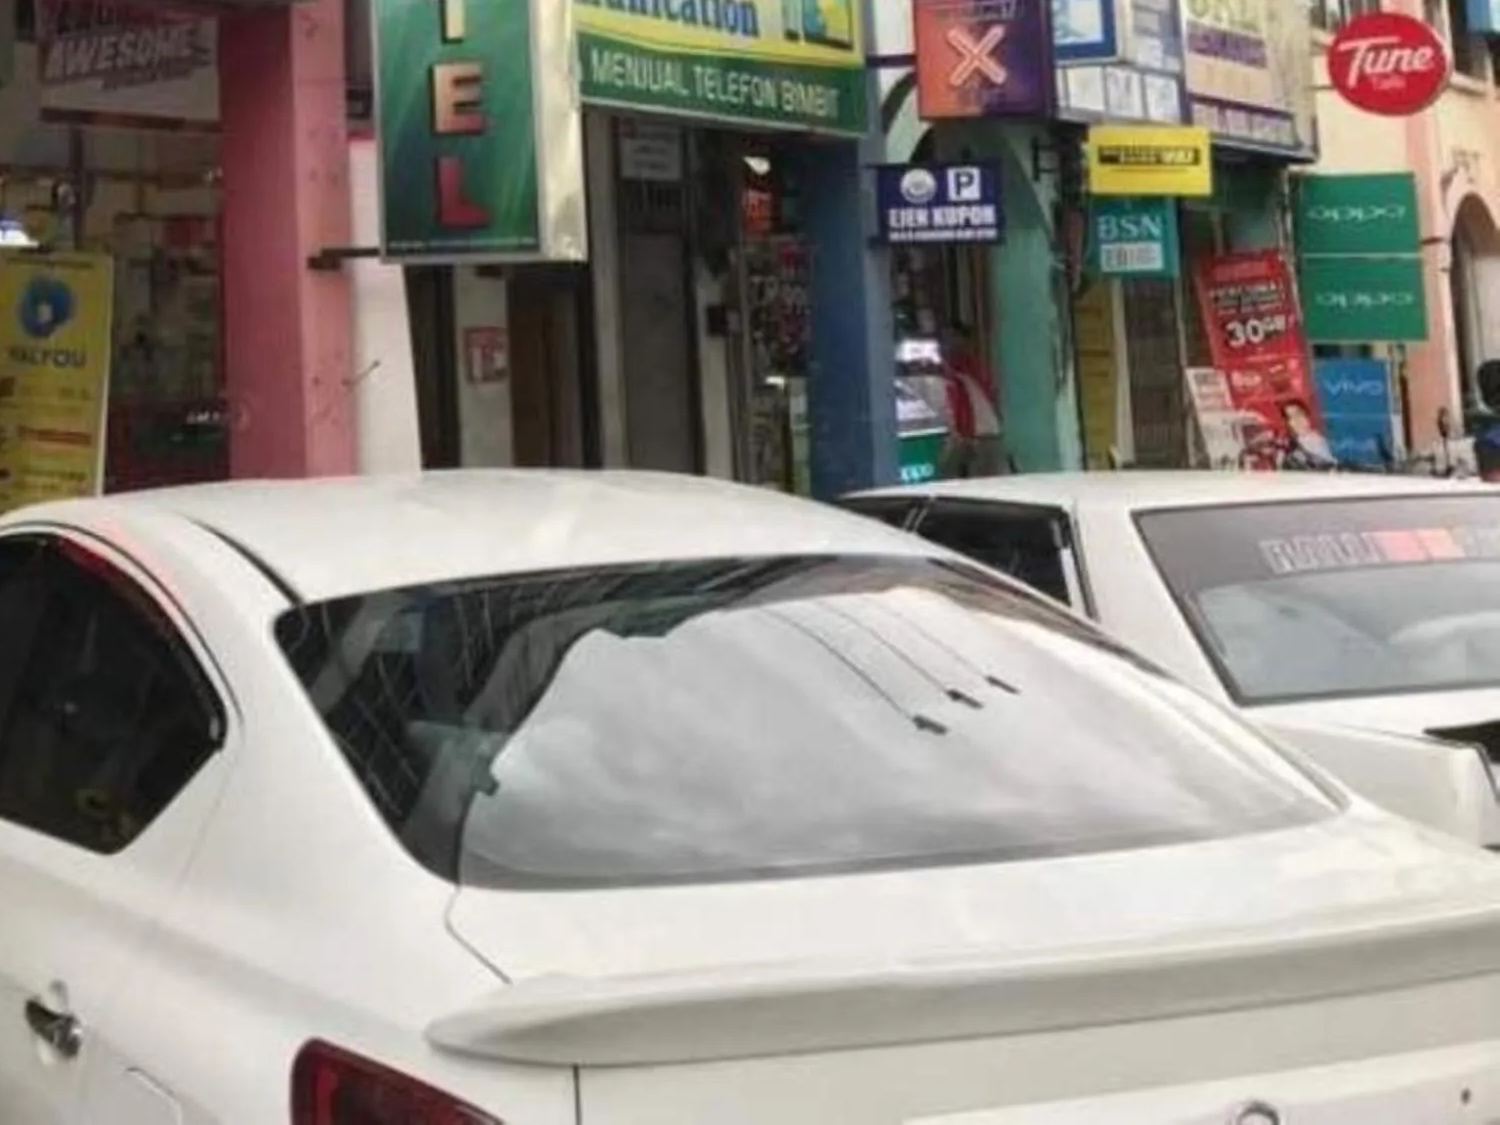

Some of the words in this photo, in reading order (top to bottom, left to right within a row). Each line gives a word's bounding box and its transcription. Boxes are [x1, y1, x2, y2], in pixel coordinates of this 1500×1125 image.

[590, 49, 689, 96] MENJUAL
[693, 65, 778, 111] TELEFON
[1336, 35, 1436, 88] Tune
[954, 171, 975, 197] P
[1097, 214, 1163, 241] BSN
